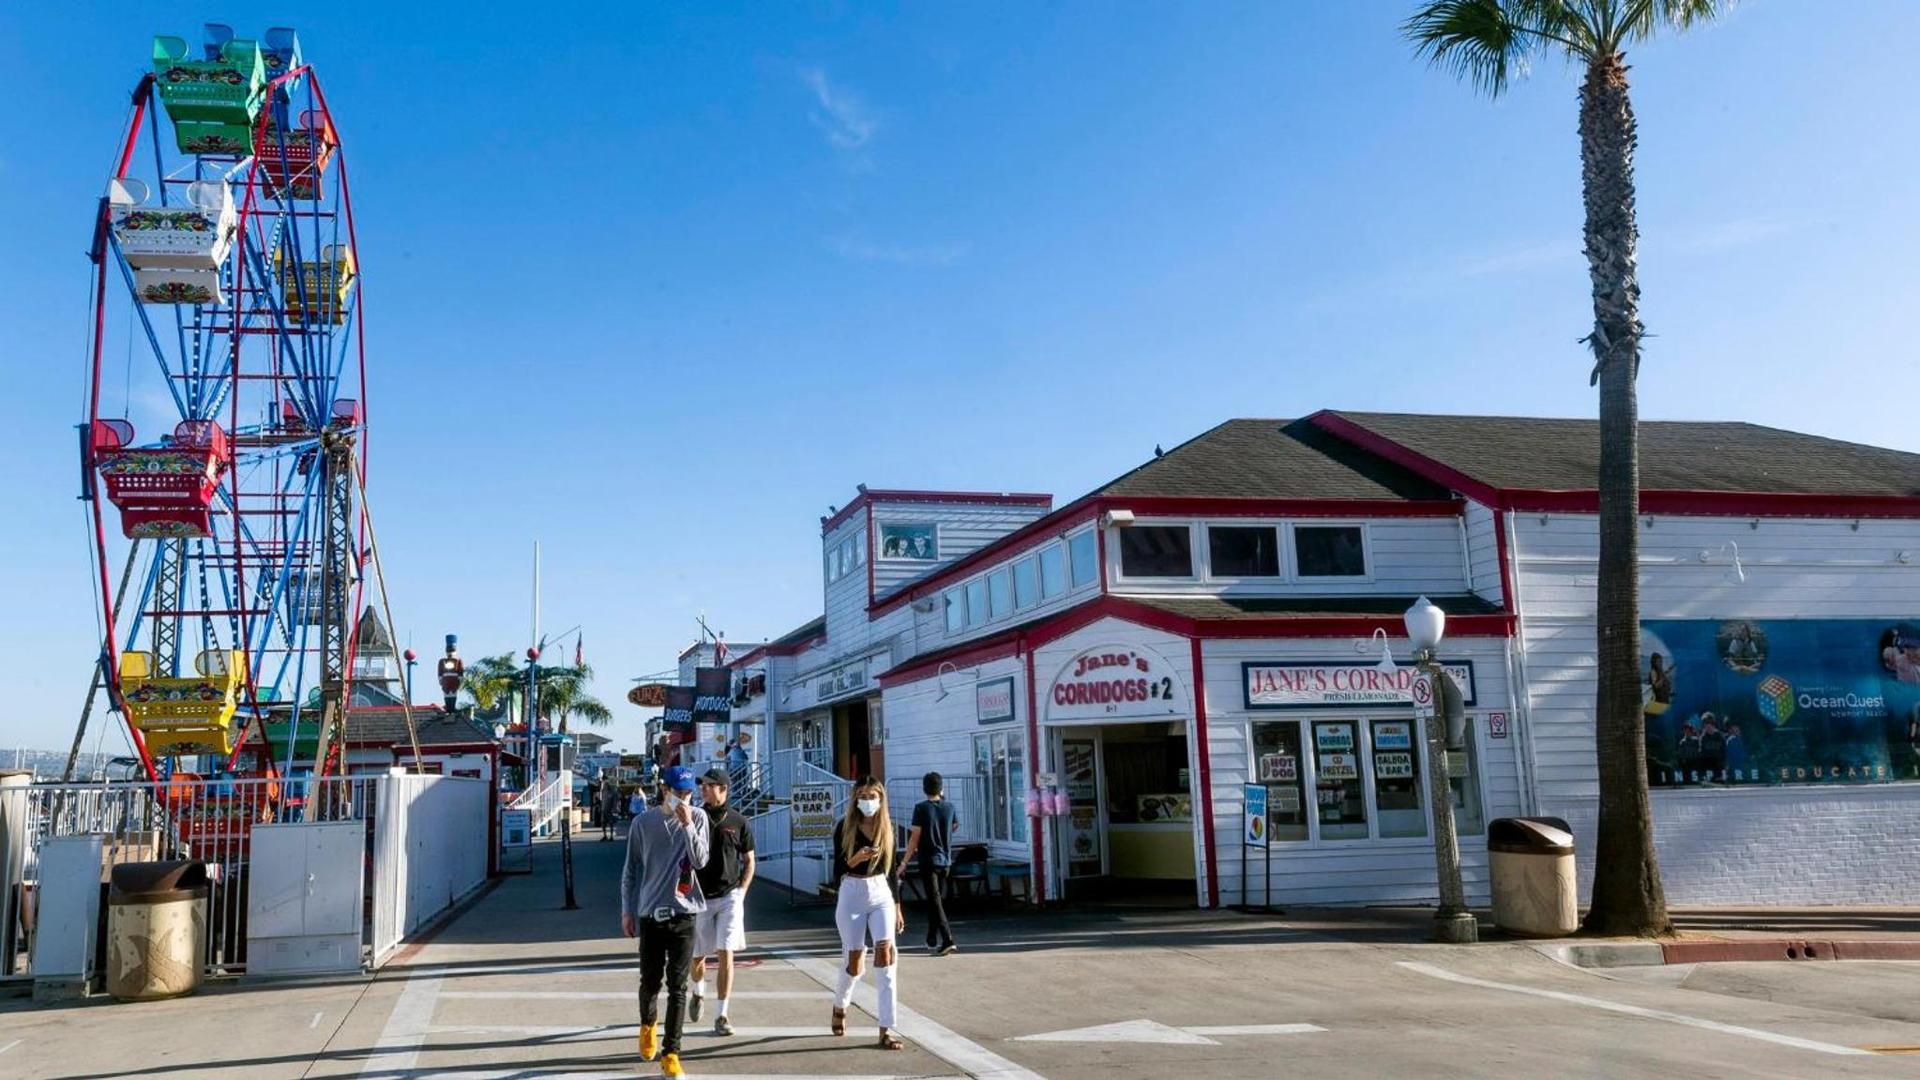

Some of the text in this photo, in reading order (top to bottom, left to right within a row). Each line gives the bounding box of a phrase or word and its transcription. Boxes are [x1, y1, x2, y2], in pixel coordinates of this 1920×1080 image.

[1074, 652, 1149, 677] Jane's
[1252, 668, 1327, 694] JANE'S
[1054, 679, 1148, 705] CORNDOGS
[1798, 692, 1885, 709] OceanQuest
[1271, 757, 1294, 767] HOT
[1272, 768, 1295, 778] DOG
[1661, 765, 1886, 783] INSPIRE EDUCATE
[793, 792, 831, 802] BALBOA
[802, 804, 823, 813] BAR
